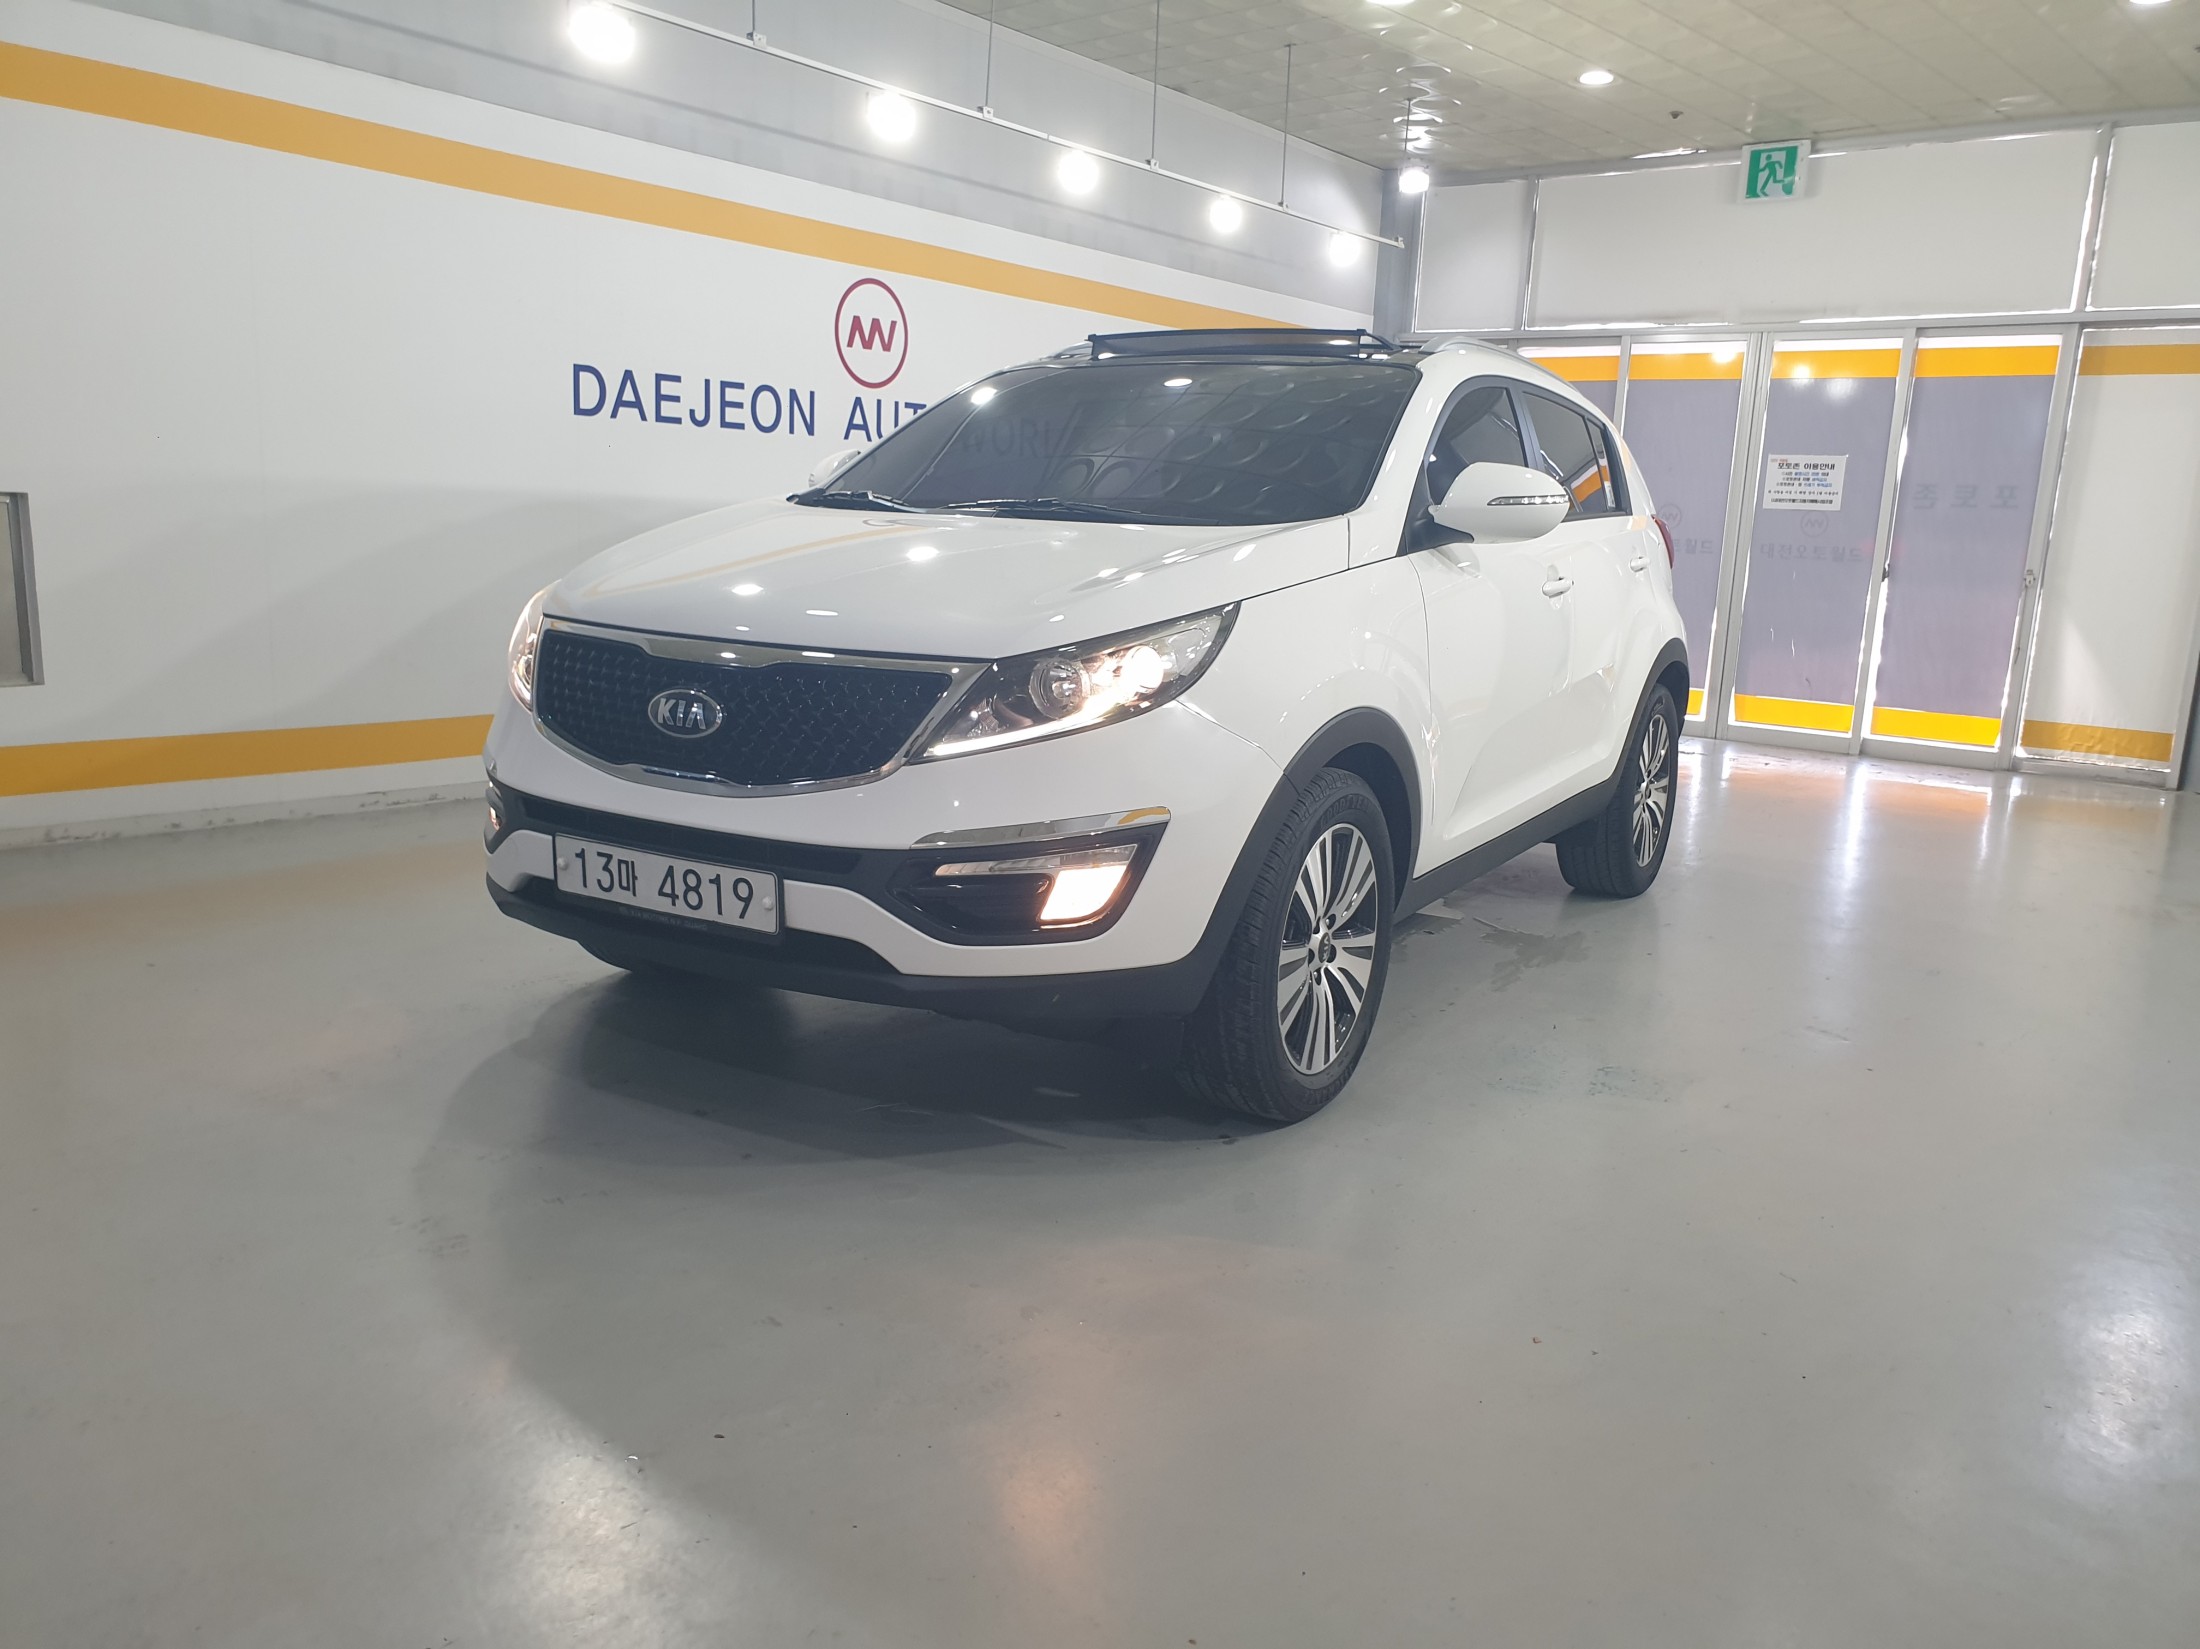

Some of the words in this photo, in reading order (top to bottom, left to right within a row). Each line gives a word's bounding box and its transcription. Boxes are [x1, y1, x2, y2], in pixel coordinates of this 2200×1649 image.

[573, 363, 815, 436] DAEJEON
[1803, 462, 1836, 471] 이용안내
[1759, 542, 1864, 562] 대전오토월드
[657, 697, 707, 730] KIA
[574, 847, 639, 897] 13마
[657, 864, 755, 920] 4819
